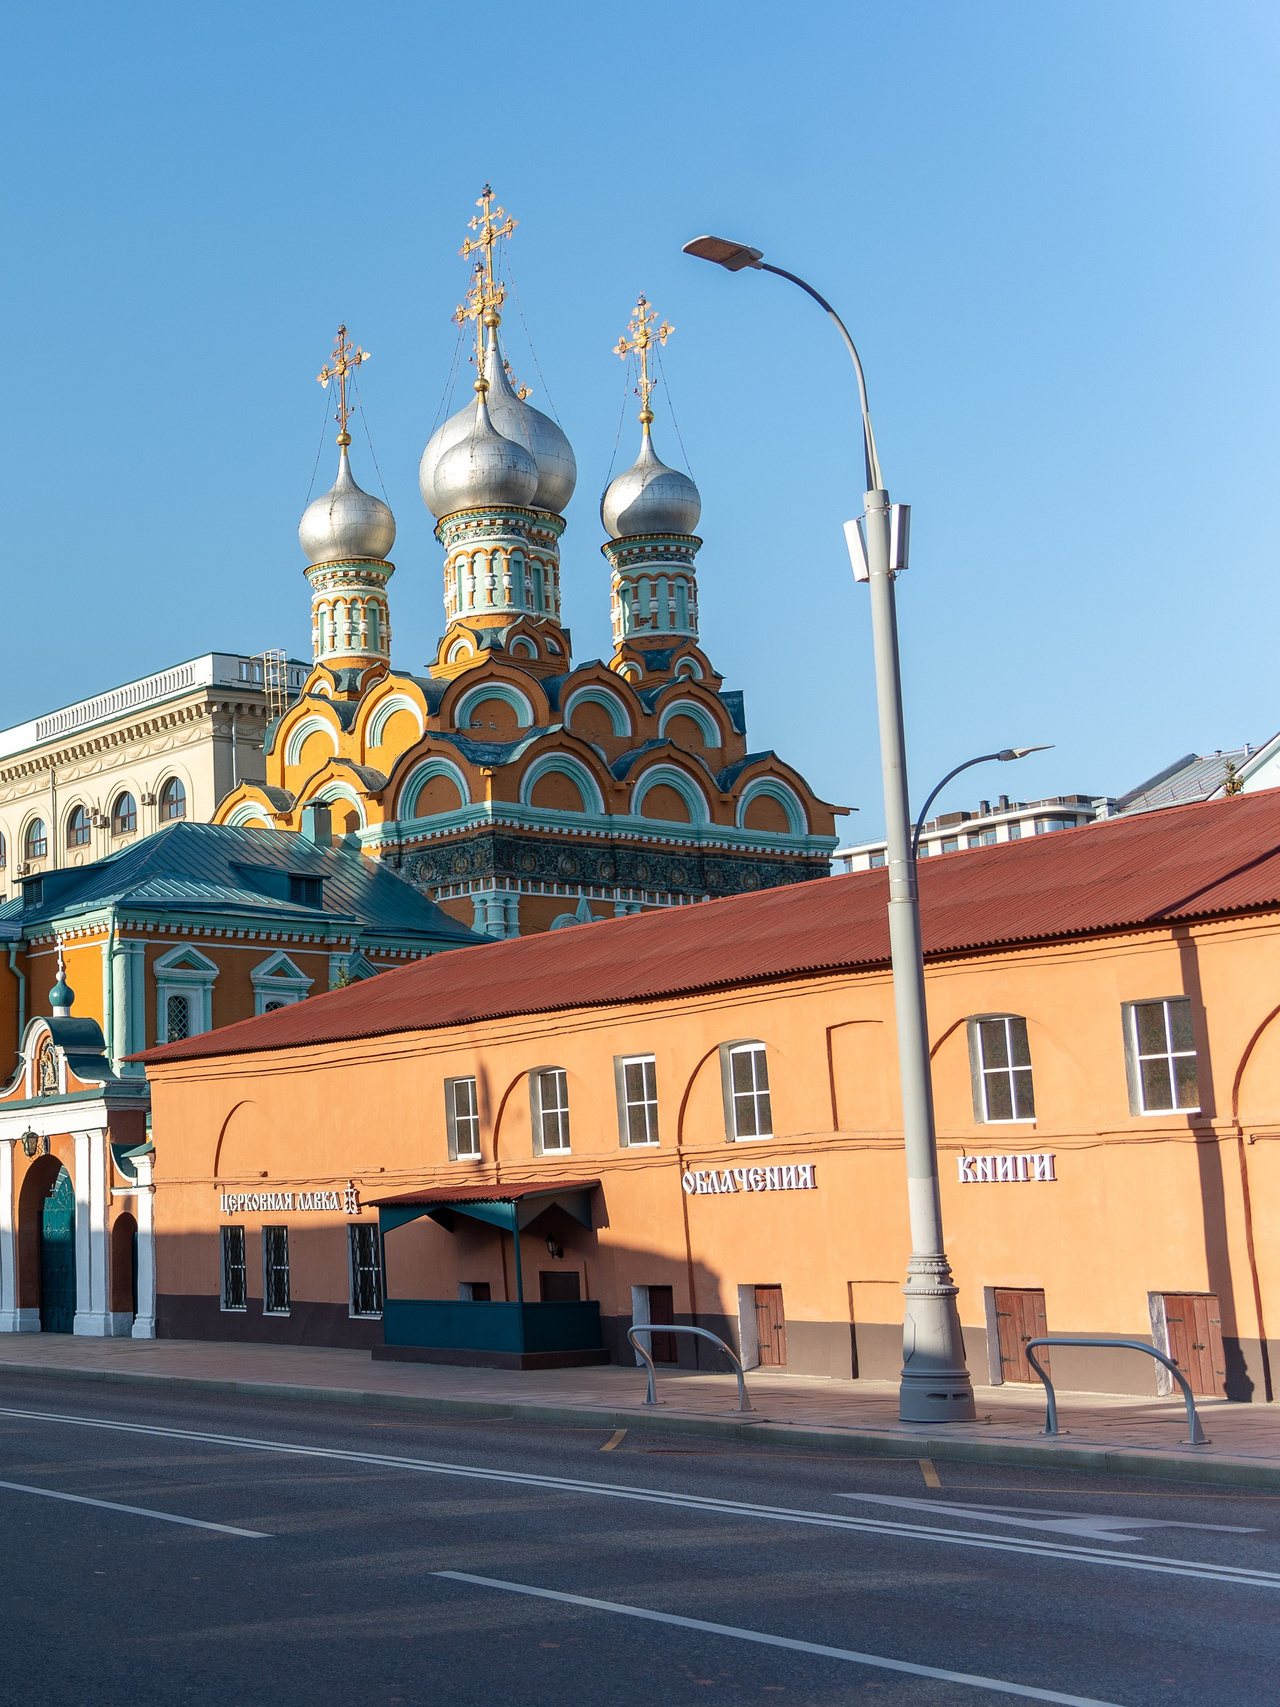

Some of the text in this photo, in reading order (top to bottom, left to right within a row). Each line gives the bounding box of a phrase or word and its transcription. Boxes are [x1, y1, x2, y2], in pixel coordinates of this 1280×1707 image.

[682, 1164, 817, 1195] ОБЛАЧЕНИЯ
[956, 1153, 1057, 1183] КНИГИ
[220, 1191, 341, 1216] ЦЕРКОВНАЯ ЛАВКА
